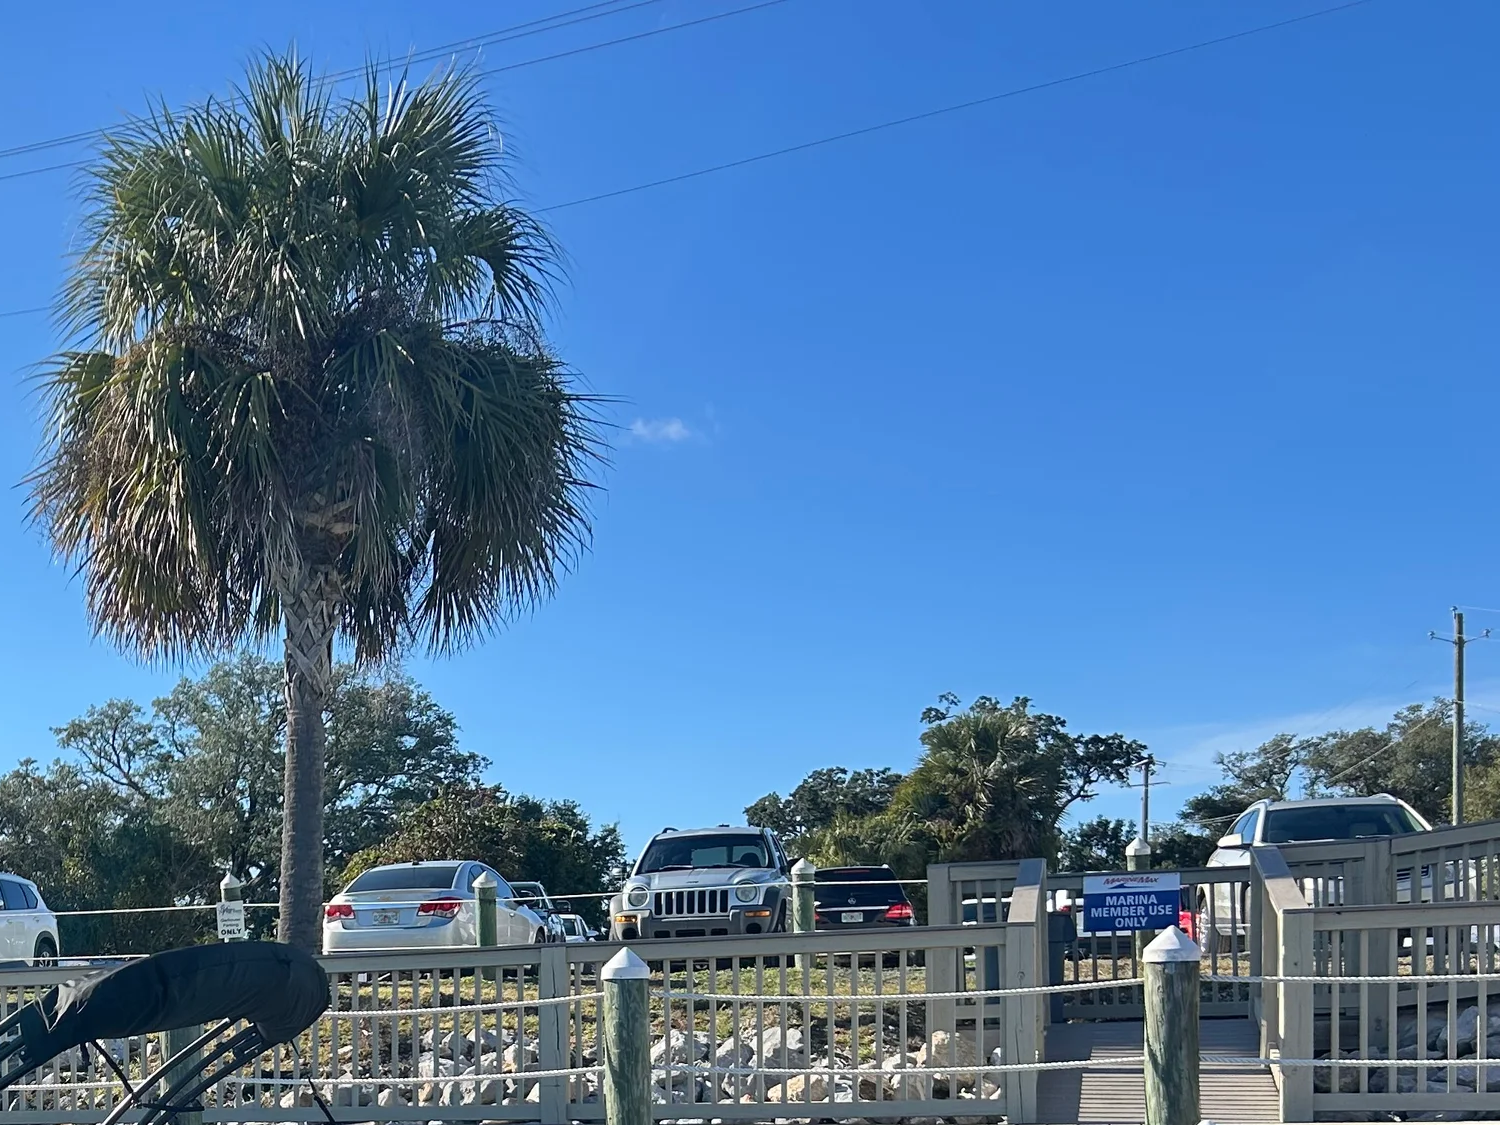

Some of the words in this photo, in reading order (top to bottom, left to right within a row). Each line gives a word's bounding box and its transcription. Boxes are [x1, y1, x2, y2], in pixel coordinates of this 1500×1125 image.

[1105, 894, 1158, 906] MARINA
[1090, 905, 1145, 918] MEMBER
[1148, 904, 1173, 916] USE
[1114, 916, 1148, 928] ONLY
[220, 928, 242, 936] ONLY
